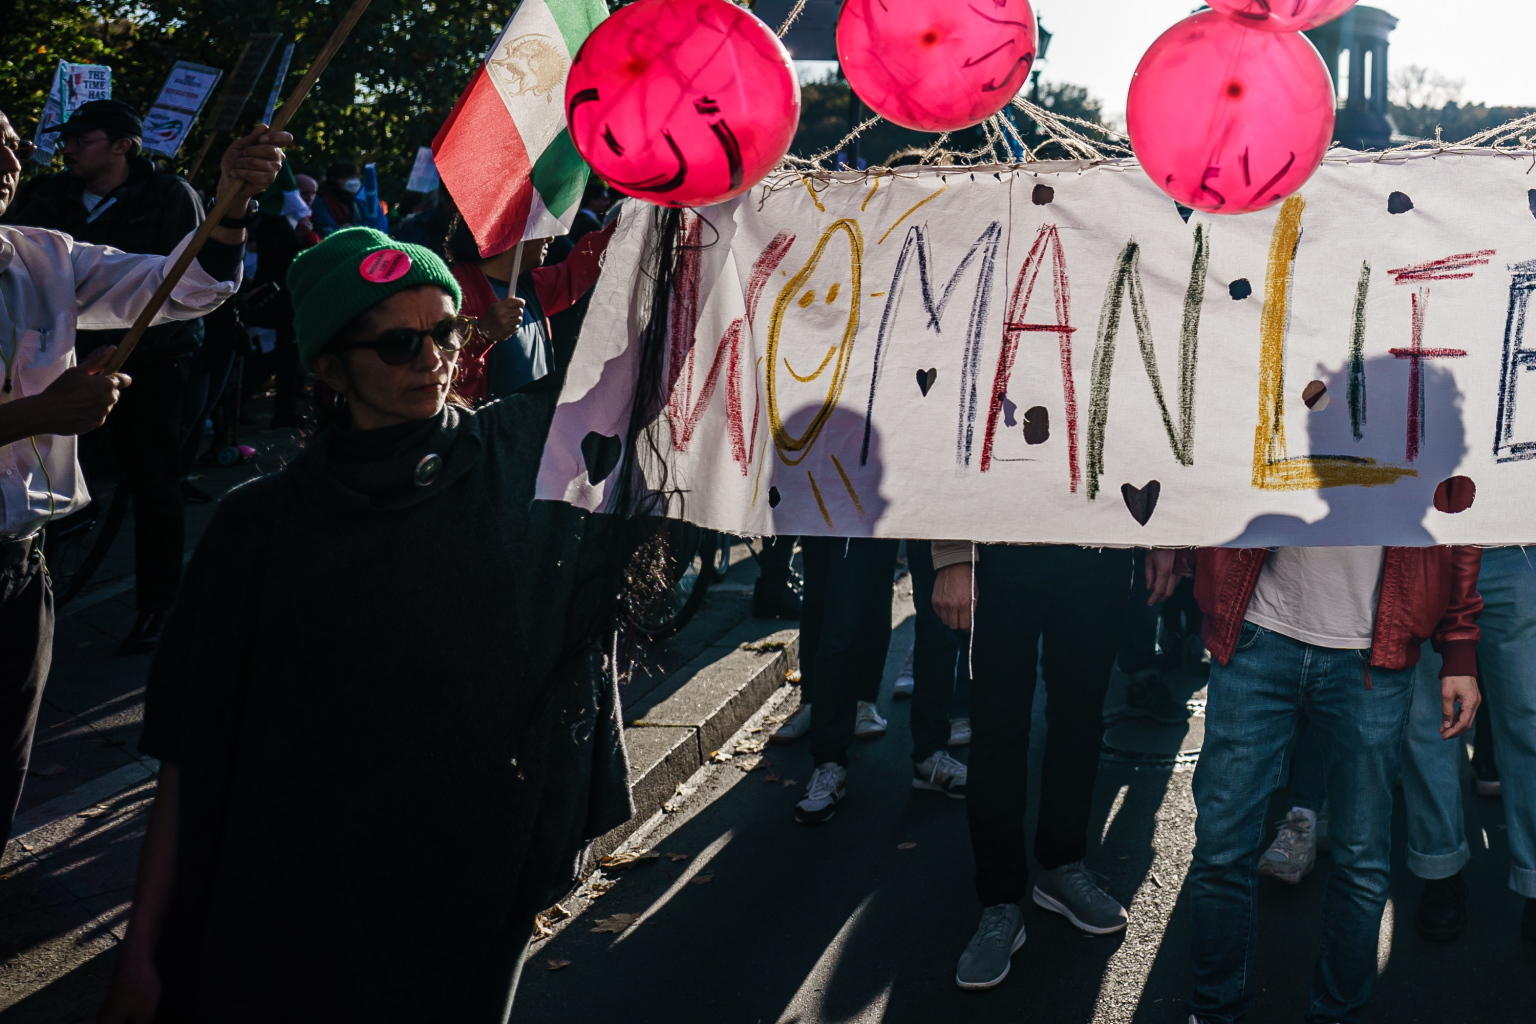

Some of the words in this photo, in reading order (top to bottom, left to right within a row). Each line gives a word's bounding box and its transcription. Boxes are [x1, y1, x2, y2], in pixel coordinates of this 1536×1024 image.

[88, 70, 106, 81] THE
[82, 80, 106, 90] TIME
[668, 210, 1211, 503] WOMAN
